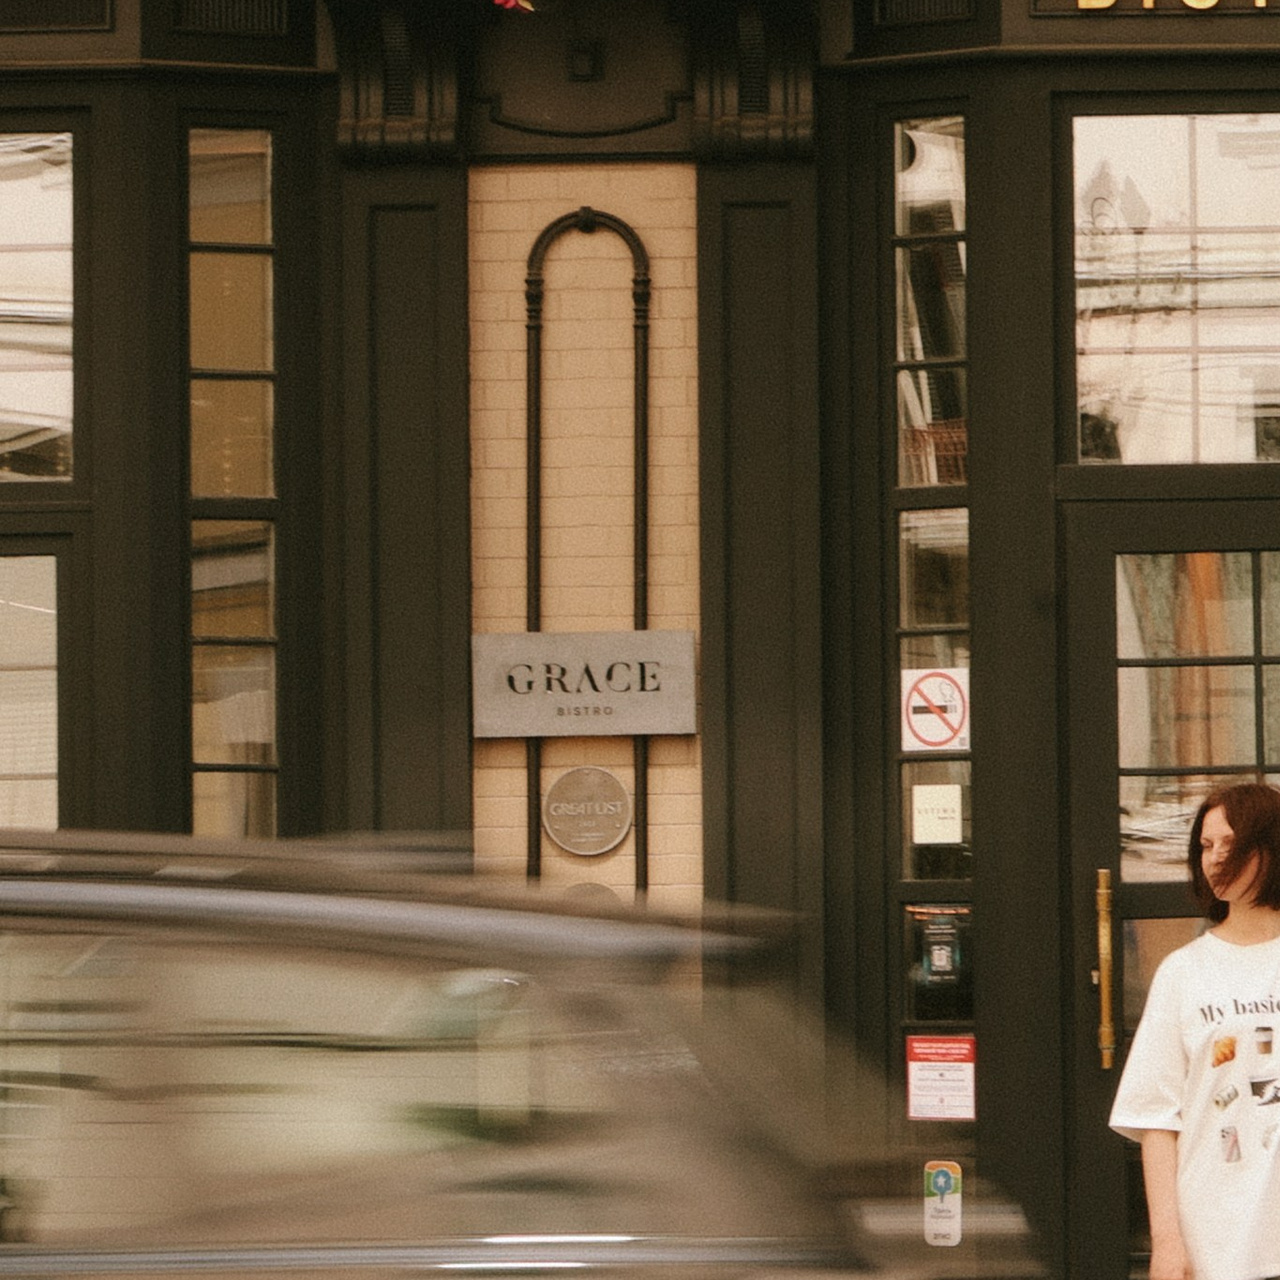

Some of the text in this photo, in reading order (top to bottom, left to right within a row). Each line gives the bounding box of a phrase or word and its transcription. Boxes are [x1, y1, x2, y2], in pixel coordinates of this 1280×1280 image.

[507, 662, 660, 694] GRACE
[556, 706, 613, 716] BISTRO
[550, 801, 623, 816] GREAT LIST
[1199, 1004, 1226, 1025] My
